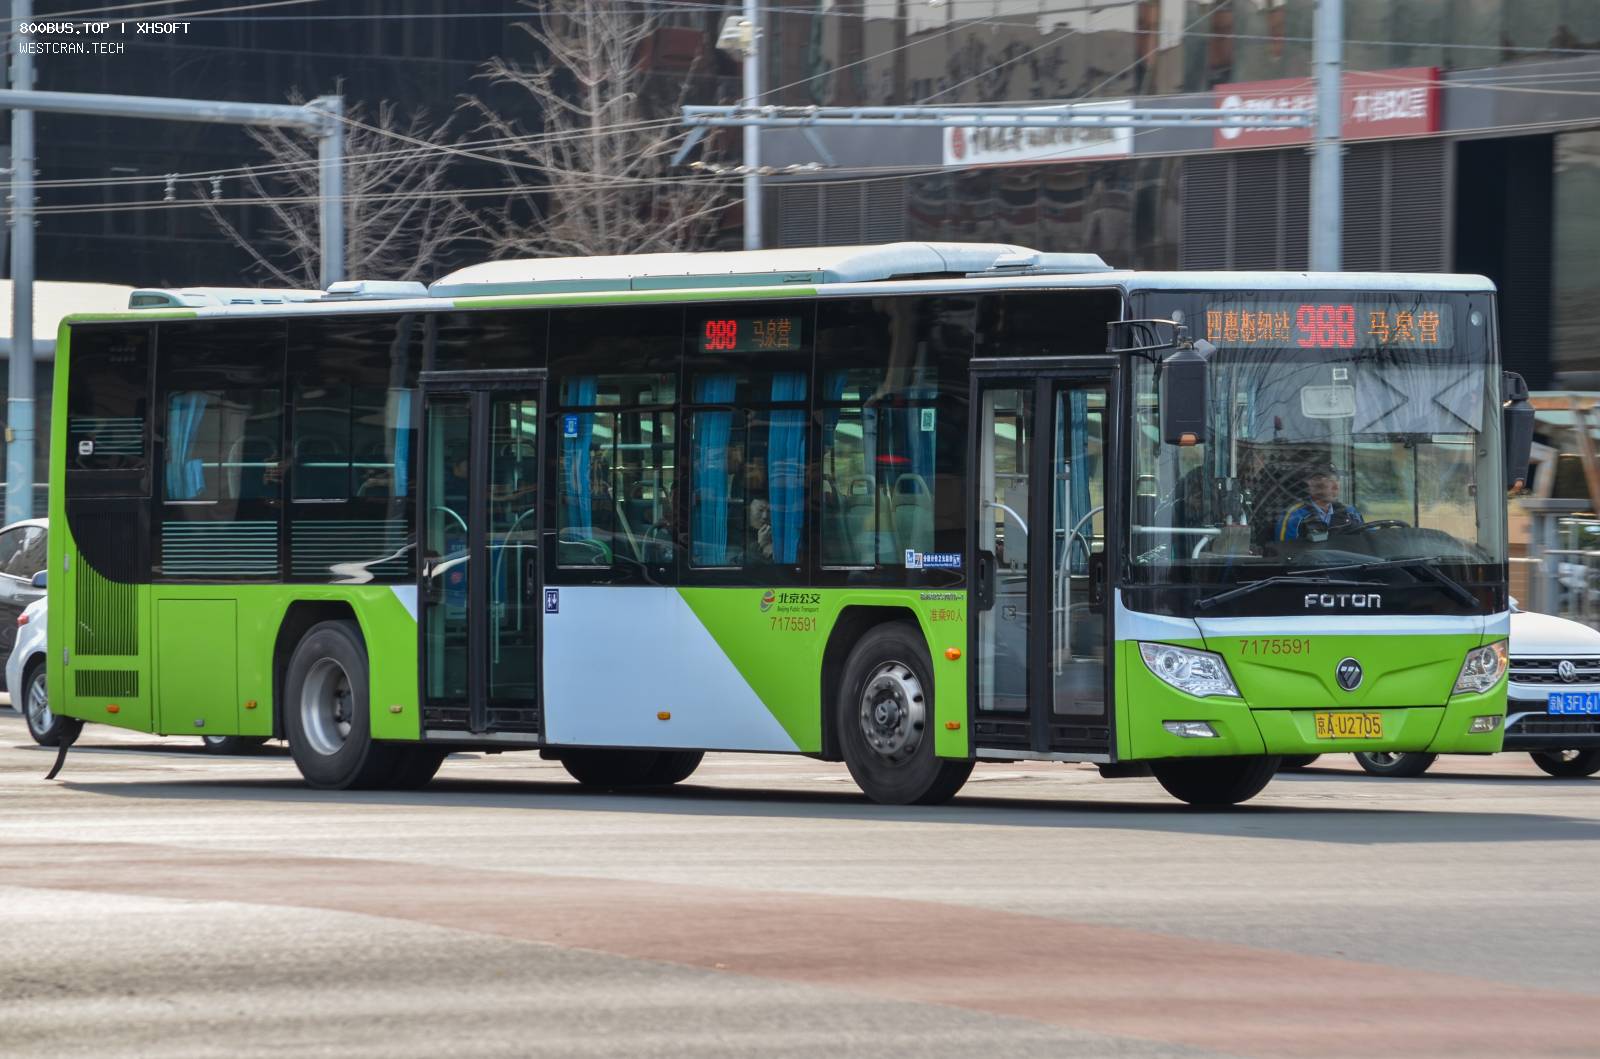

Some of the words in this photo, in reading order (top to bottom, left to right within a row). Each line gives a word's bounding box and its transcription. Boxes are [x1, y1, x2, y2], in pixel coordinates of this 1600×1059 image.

[1296, 303, 1356, 348] 988
[704, 319, 738, 350] 988
[777, 592, 822, 605] 北京公交
[1304, 593, 1382, 608] FOTON
[770, 616, 817, 632] 7175591
[1239, 639, 1311, 655] 7175591
